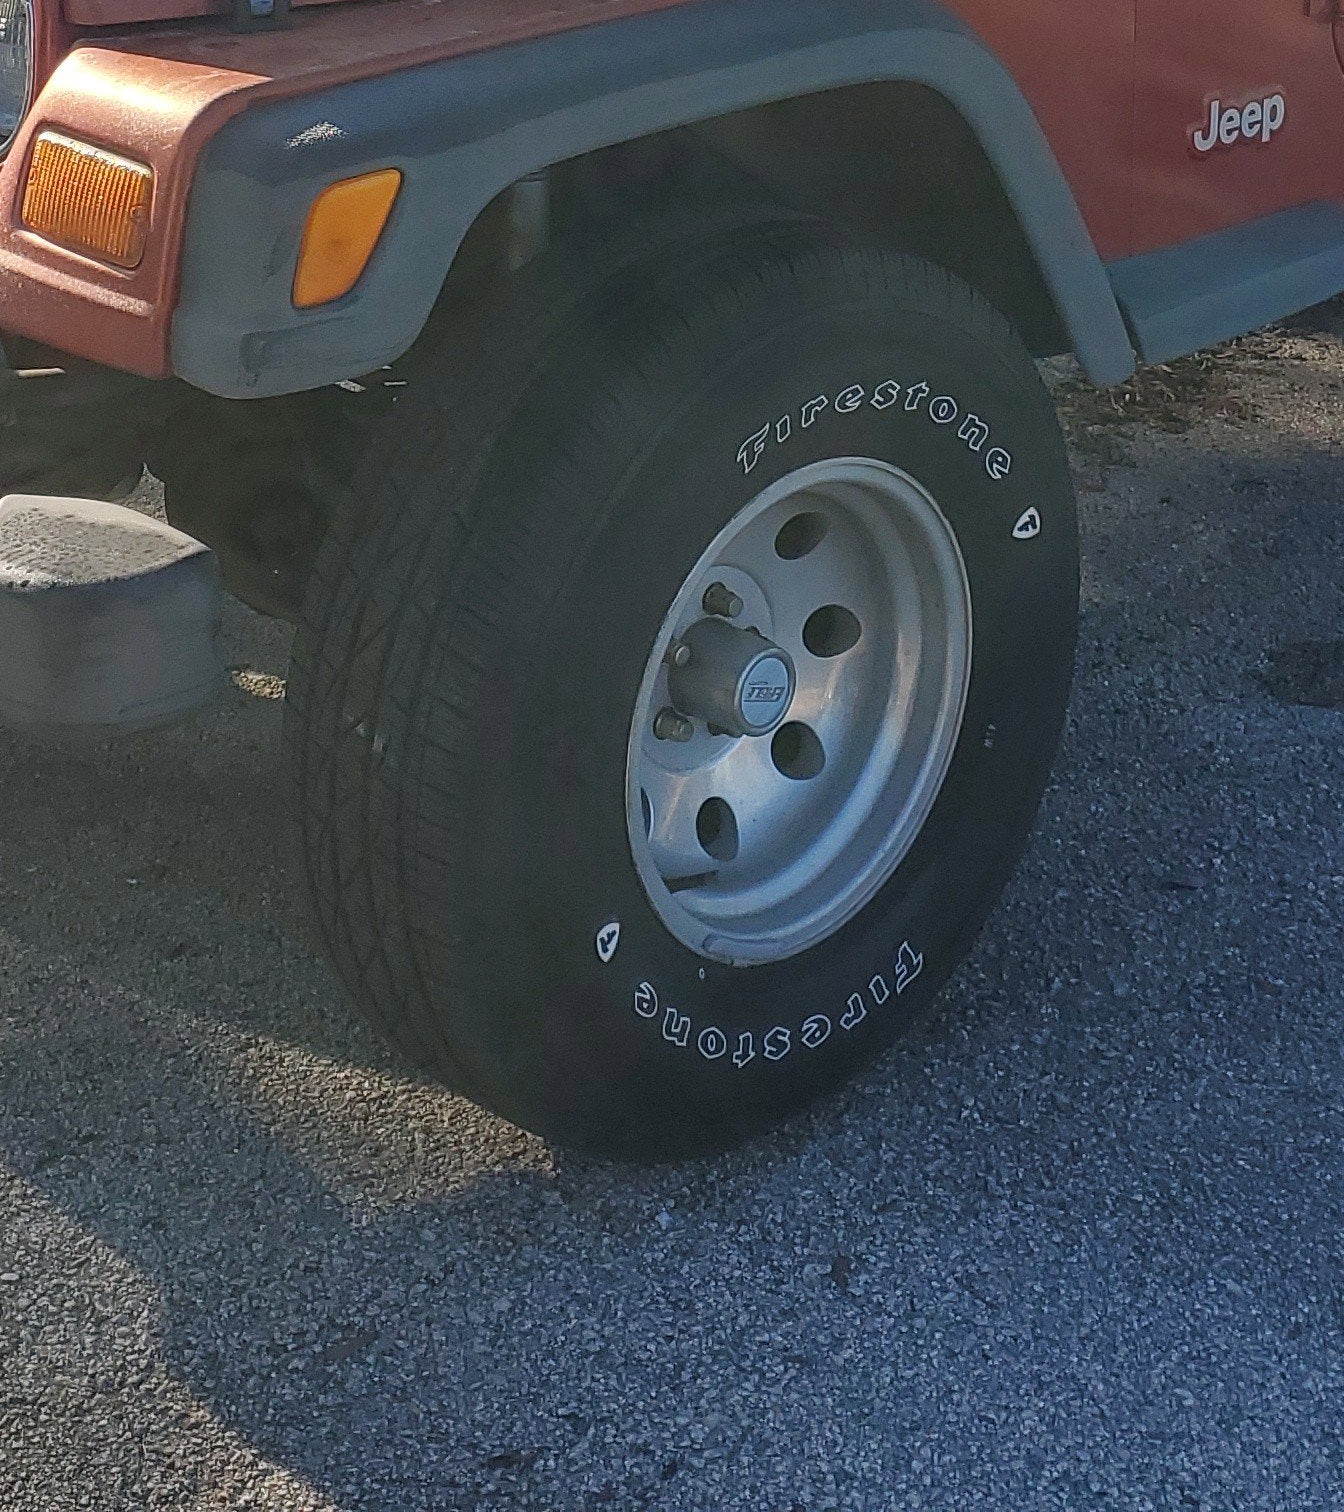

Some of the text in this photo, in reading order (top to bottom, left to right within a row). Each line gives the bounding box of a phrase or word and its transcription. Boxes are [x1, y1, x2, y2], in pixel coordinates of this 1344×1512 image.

[1193, 93, 1285, 152] Jeep
[736, 379, 1013, 480] Firestone
[633, 940, 924, 1068] Firestone
